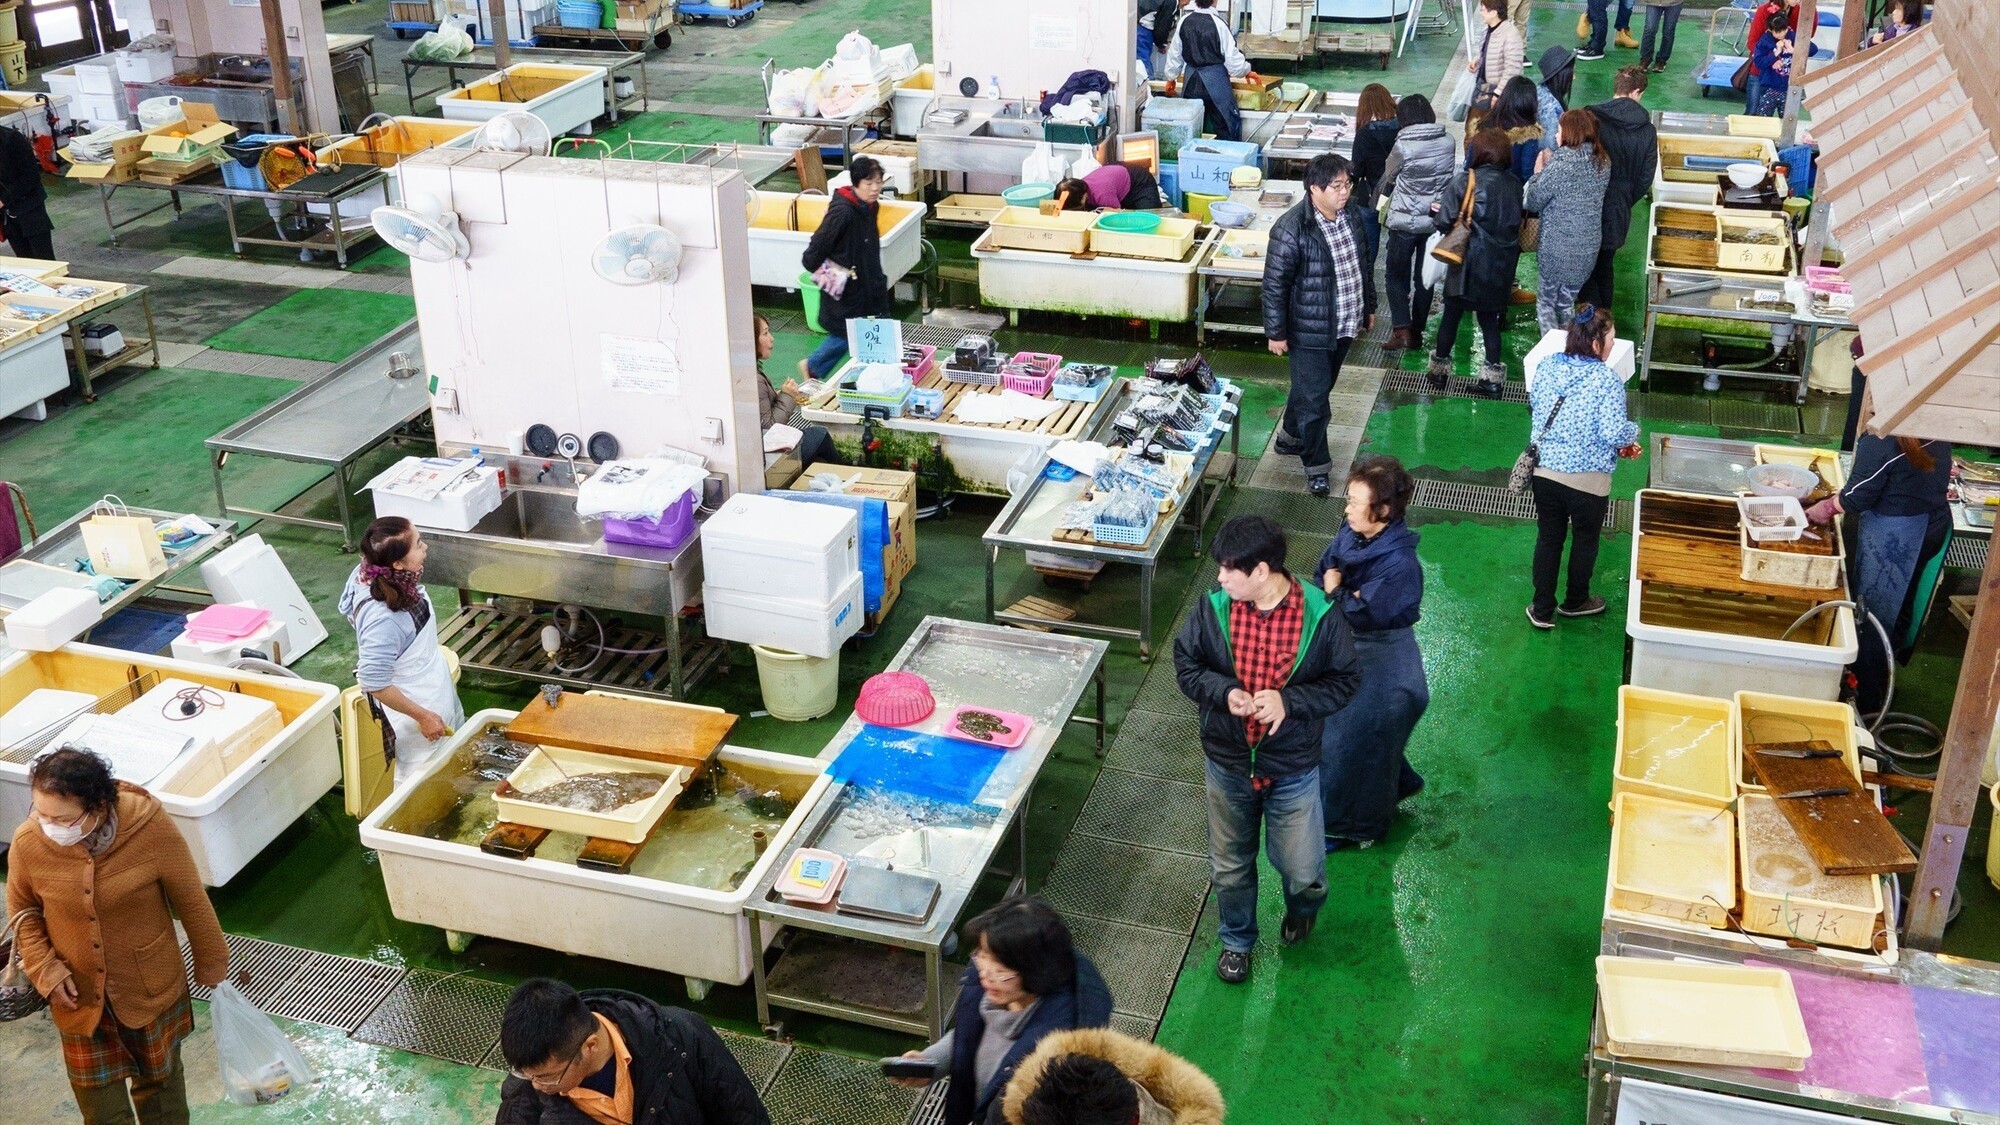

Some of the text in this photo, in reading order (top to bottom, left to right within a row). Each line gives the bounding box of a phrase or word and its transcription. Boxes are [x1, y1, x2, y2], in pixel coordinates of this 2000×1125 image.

[12, 54, 24, 80] 山下
[1191, 165, 1229, 183] 山和
[802, 860, 822, 879] 1000
